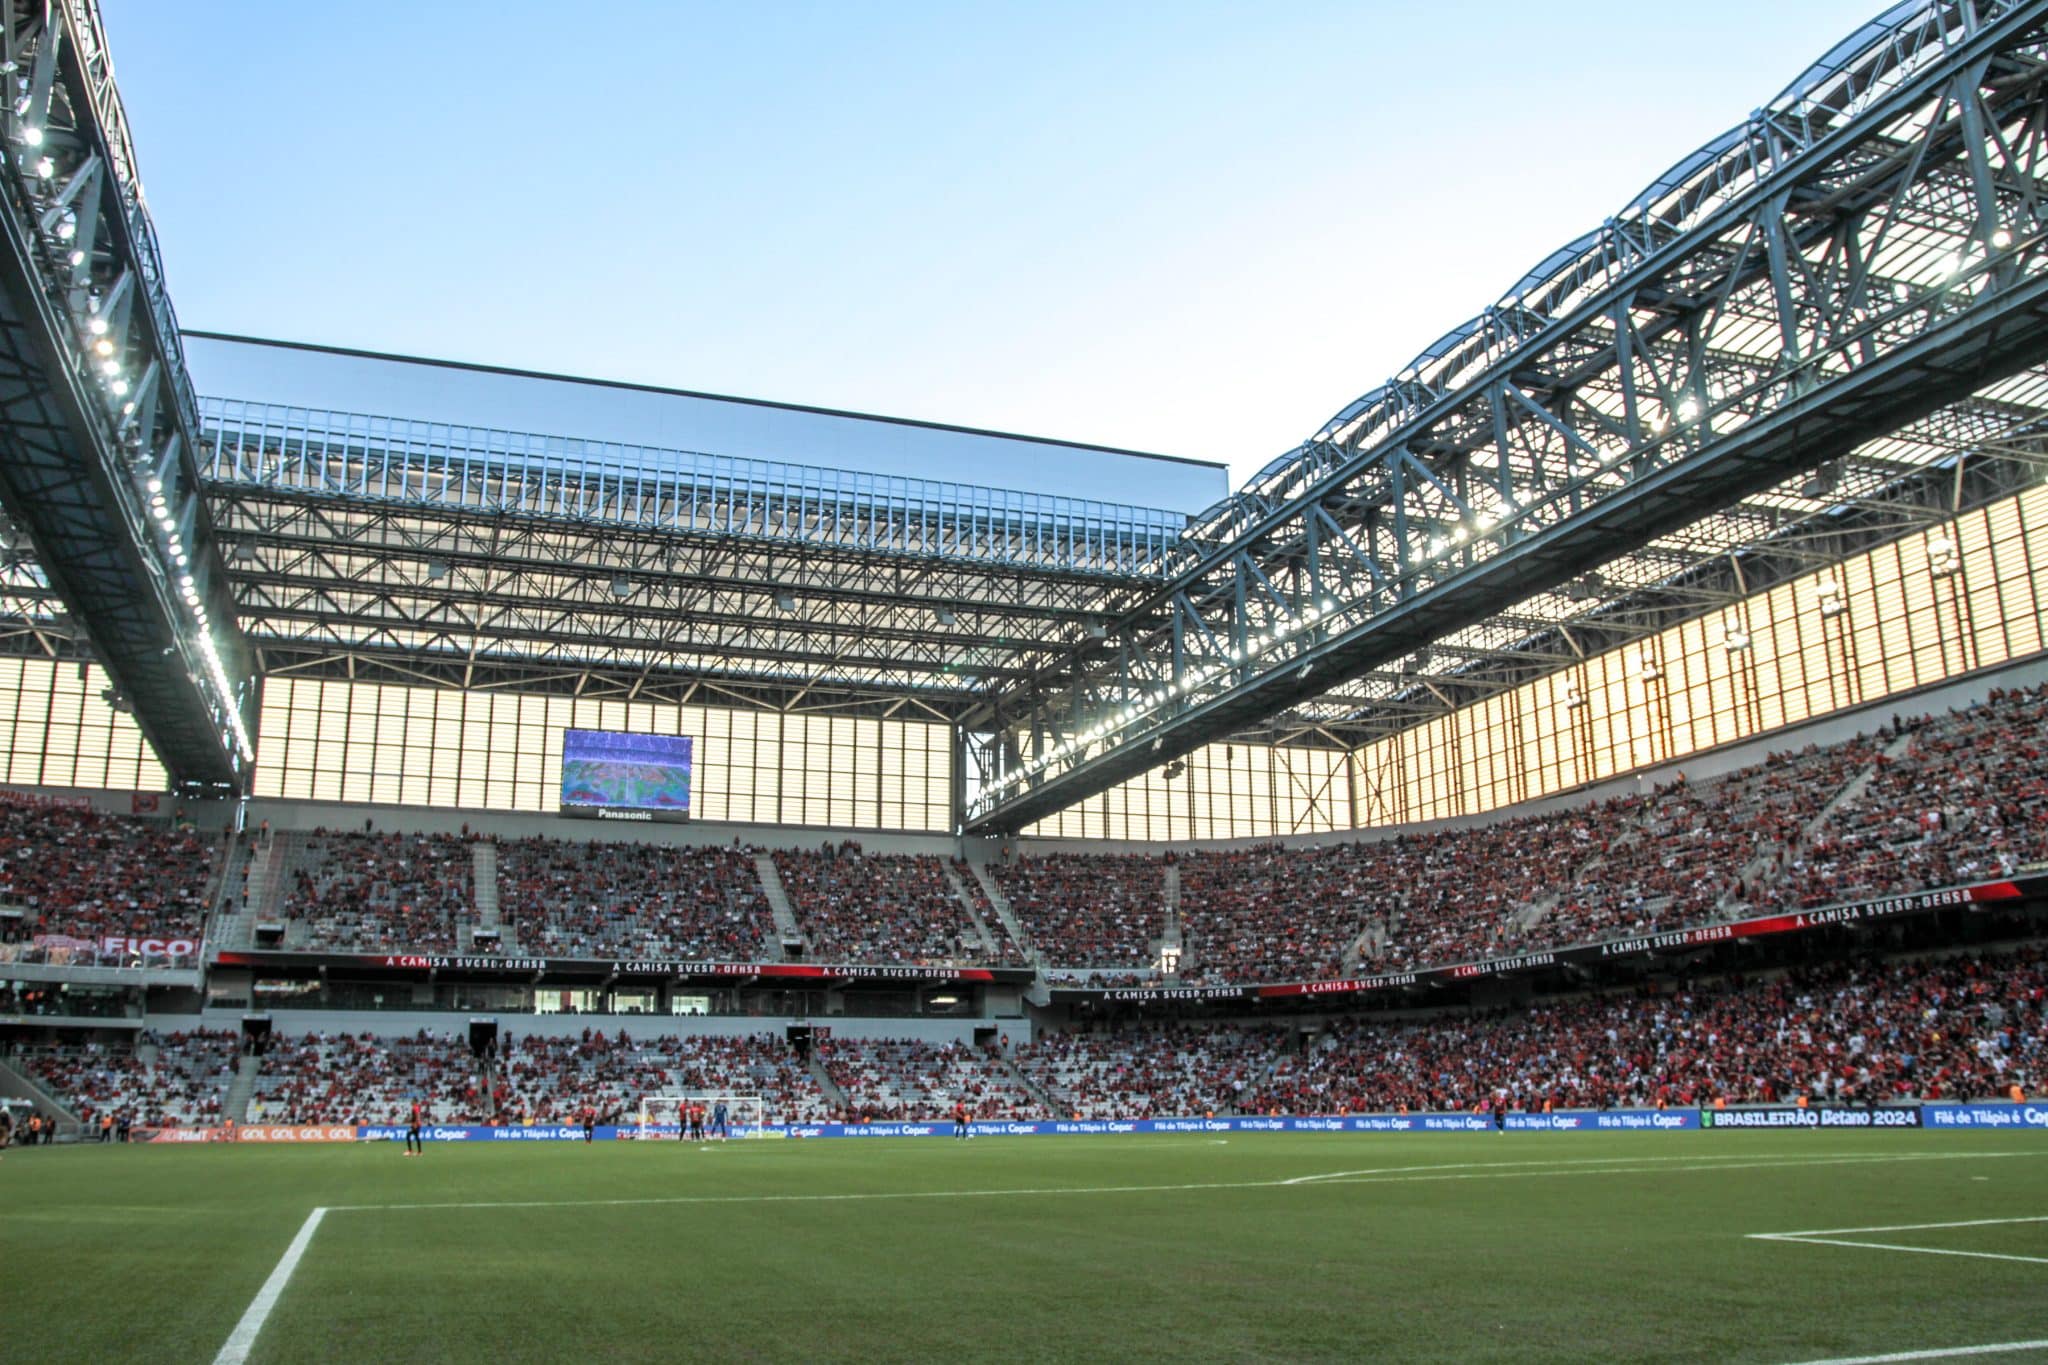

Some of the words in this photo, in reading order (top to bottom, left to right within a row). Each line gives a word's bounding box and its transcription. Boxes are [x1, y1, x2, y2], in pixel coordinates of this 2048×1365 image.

[598, 809, 652, 820] Panasonic
[1796, 915, 1805, 927] A
[1810, 907, 1860, 925] CAMISA
[1602, 945, 1608, 955] A
[1612, 939, 1649, 954] CAMISA
[386, 957, 394, 966] A
[400, 957, 448, 967] CAMISA
[613, 962, 619, 971] A
[626, 963, 671, 972] CAMISA
[823, 968, 829, 976] A
[835, 968, 876, 977] CAMISA
[1301, 984, 1307, 992] A
[1312, 982, 1349, 992] CAMISA
[1116, 991, 1158, 999] CAMISA
[1715, 1109, 1818, 1125] BRASILEIRÃO
[1821, 1110, 1870, 1125] Betano
[1874, 1111, 1916, 1125] 2024
[1934, 1110, 1954, 1124] Filé
[1956, 1111, 1971, 1123] de
[1972, 1110, 2010, 1126] Tilápia
[2012, 1110, 2020, 1123] é
